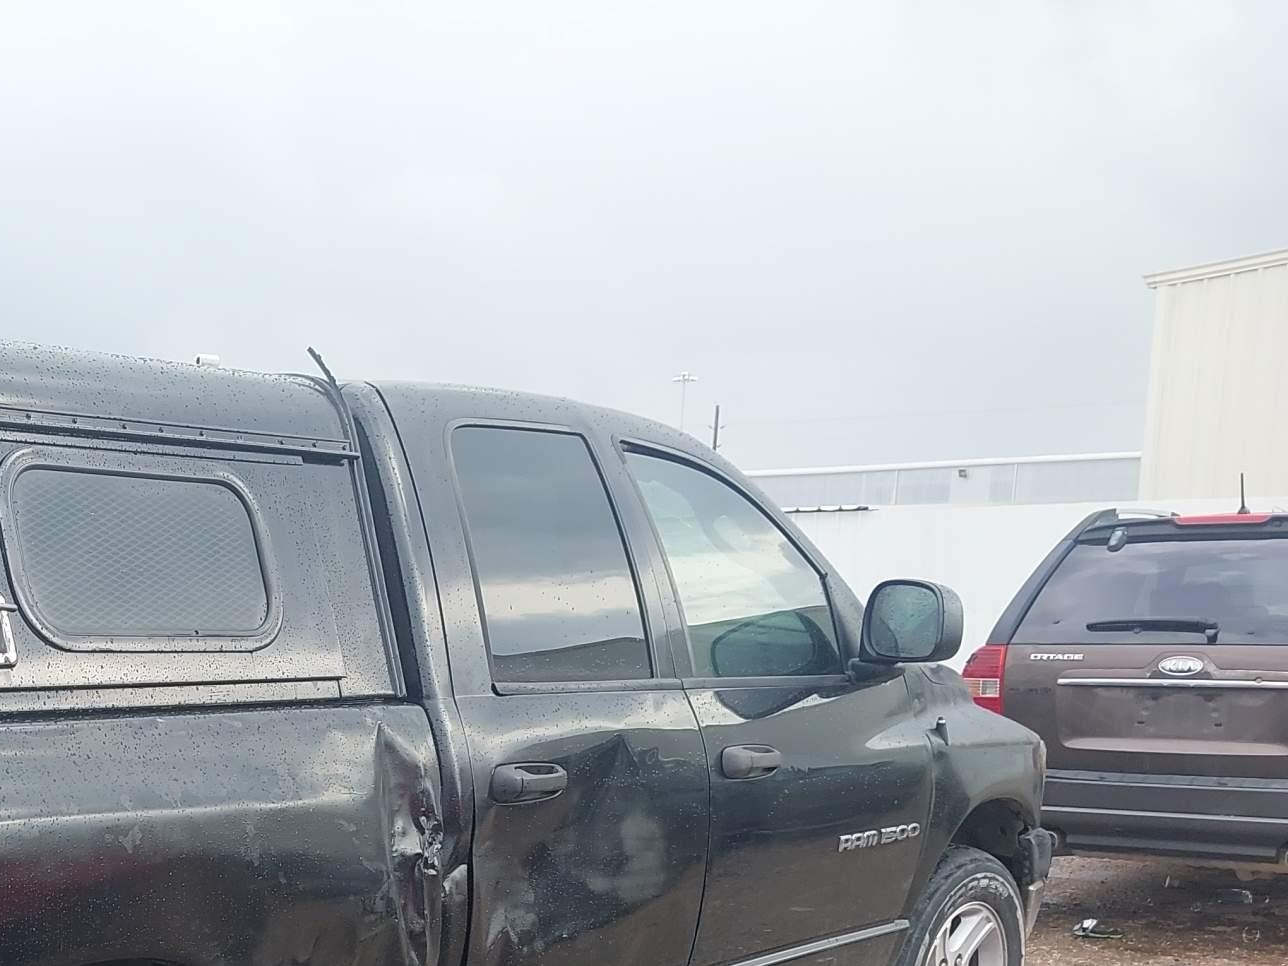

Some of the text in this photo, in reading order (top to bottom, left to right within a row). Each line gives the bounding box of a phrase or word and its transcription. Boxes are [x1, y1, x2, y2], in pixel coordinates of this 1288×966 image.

[1161, 658, 1202, 673] KIA
[838, 822, 920, 853] RAM 1500
